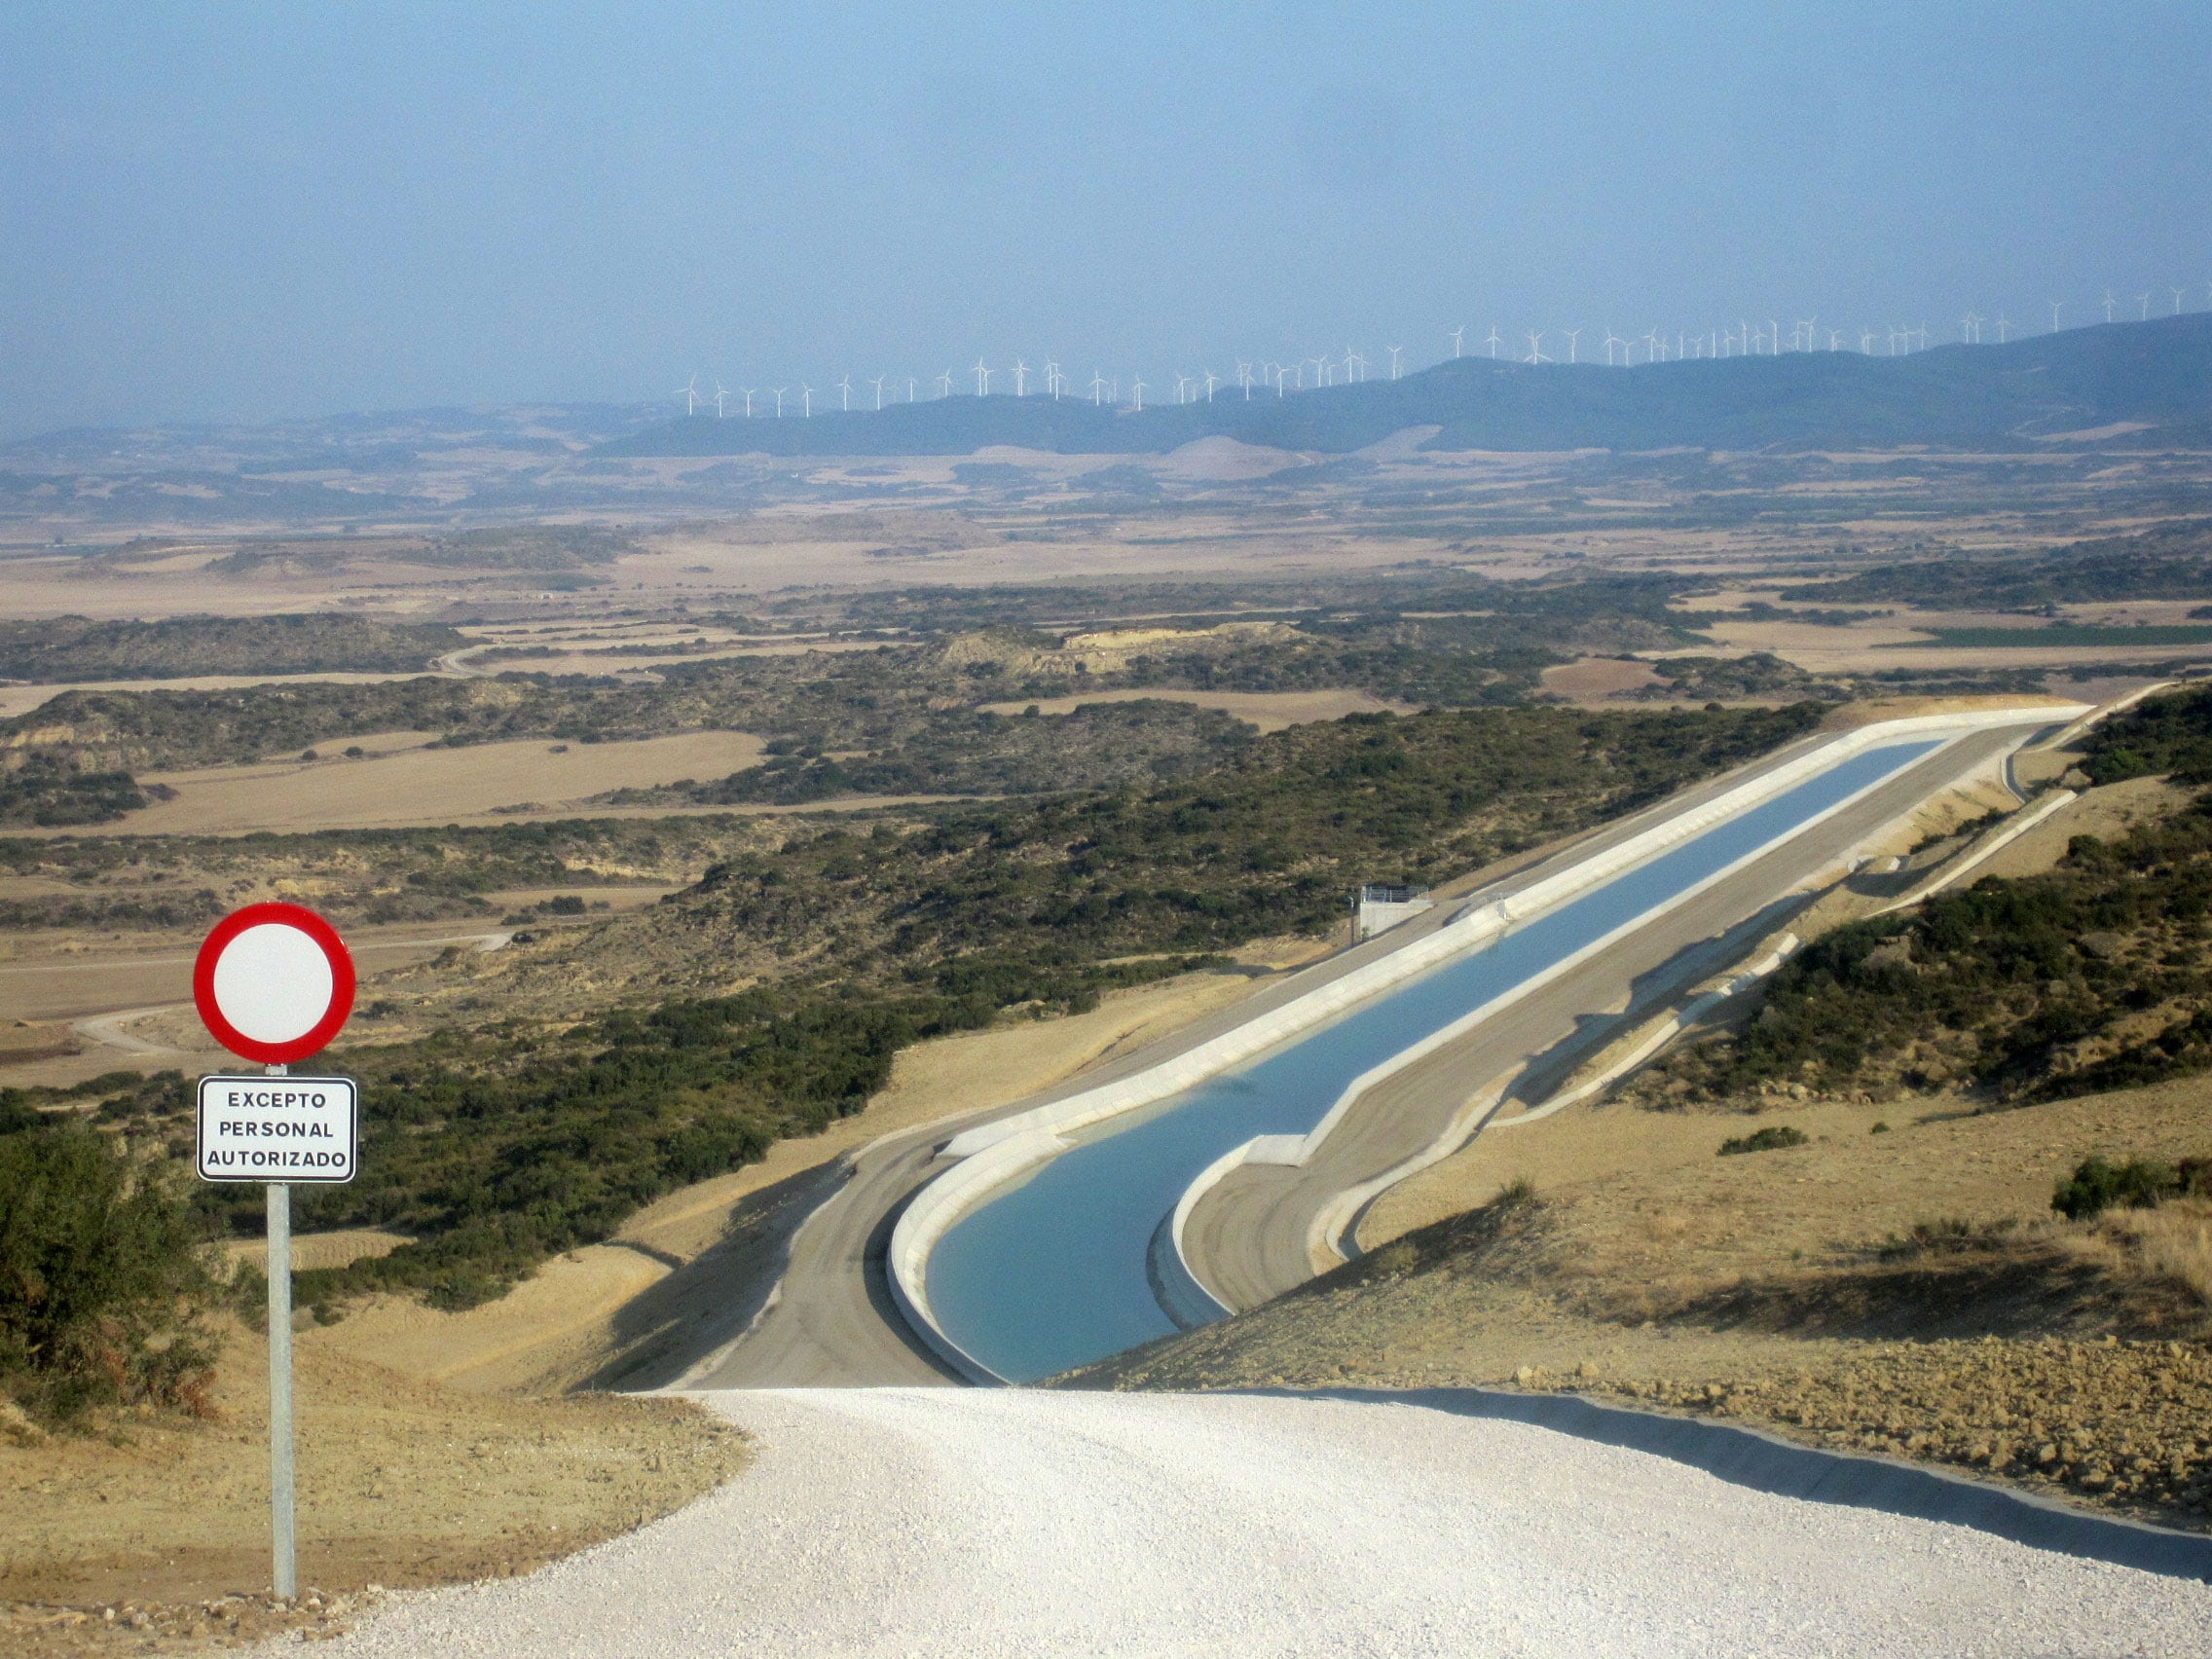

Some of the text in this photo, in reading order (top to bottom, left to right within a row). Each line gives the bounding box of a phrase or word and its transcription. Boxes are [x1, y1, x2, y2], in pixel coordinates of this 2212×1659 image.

[228, 1091, 326, 1109] EXCEPTO
[219, 1121, 334, 1138] PERSONAL
[206, 1150, 347, 1167] AUTORIZADO
